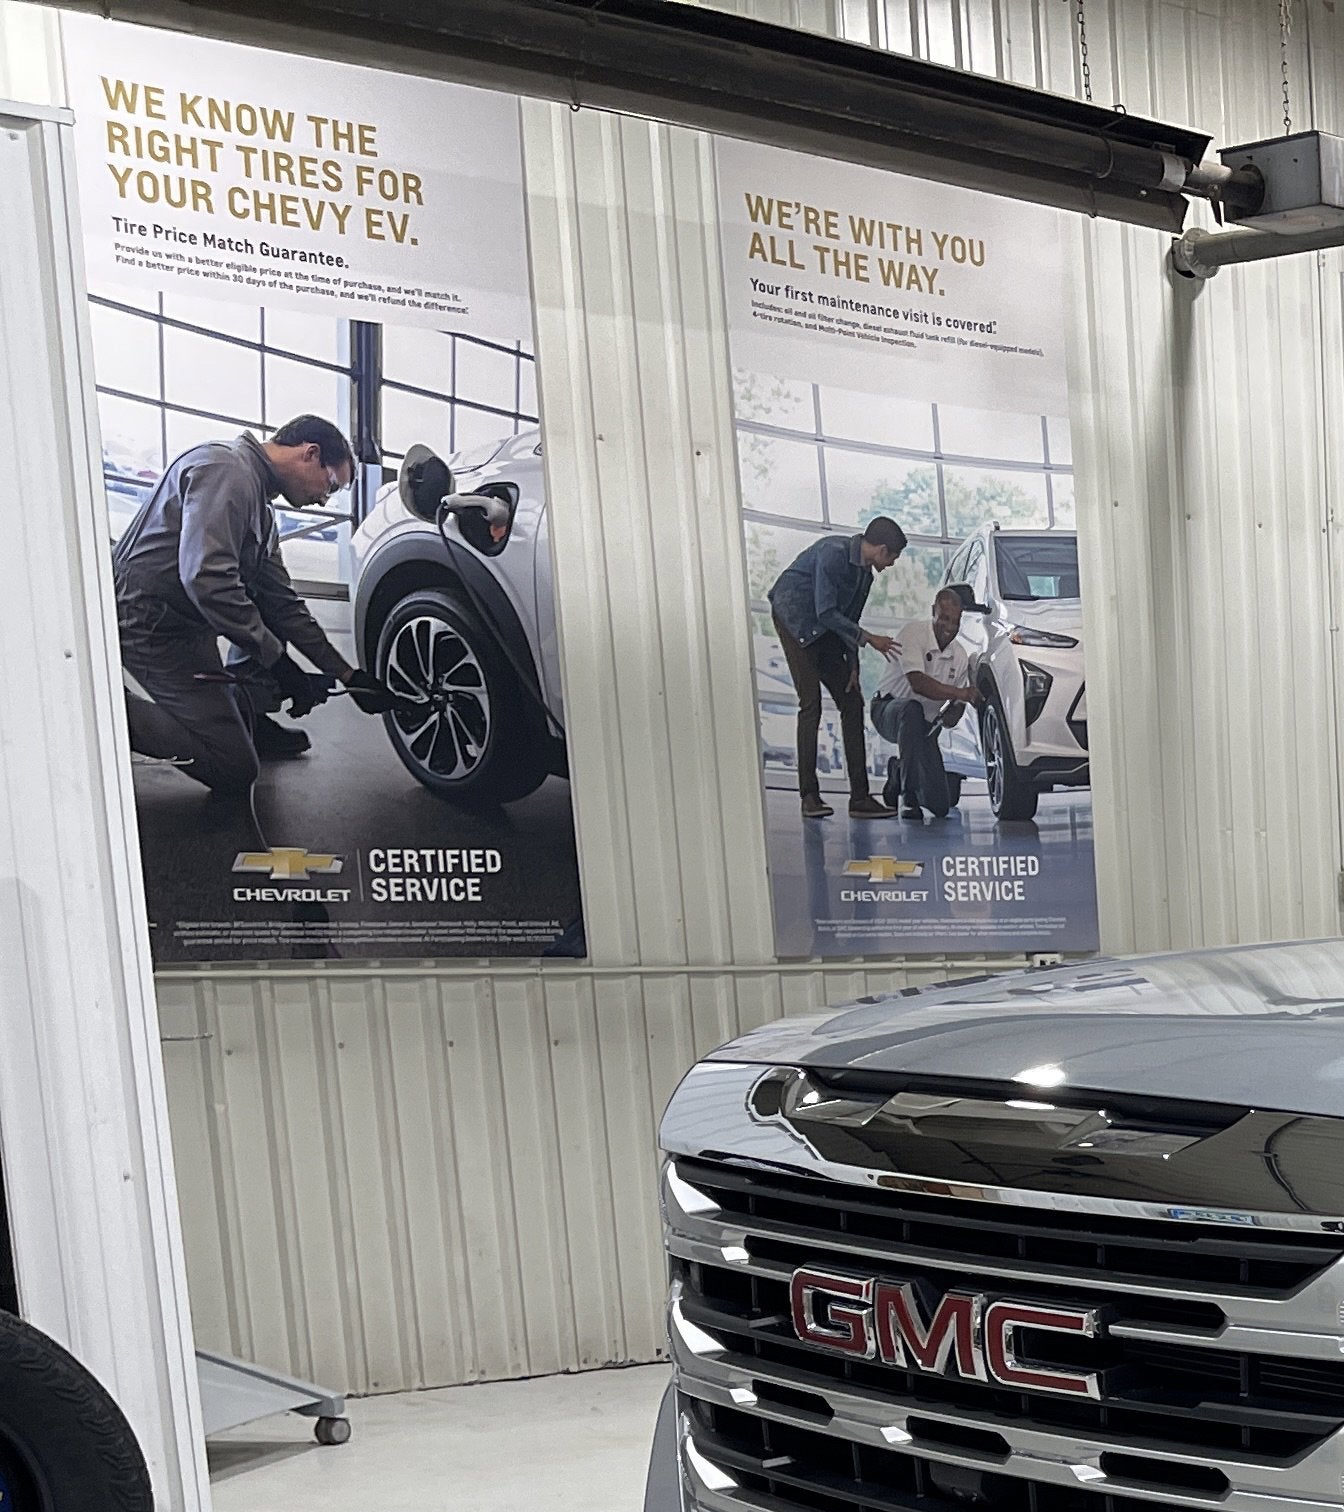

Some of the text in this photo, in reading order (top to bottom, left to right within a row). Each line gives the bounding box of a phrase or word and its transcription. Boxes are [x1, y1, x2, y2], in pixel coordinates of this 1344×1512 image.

[101, 75, 378, 157] WE KNOW THE
[107, 121, 424, 206] RIGHT TIRES FOR
[107, 163, 420, 246] YOUR CHEVY EV.
[745, 193, 985, 267] WE'RE WITH YOU
[112, 216, 349, 270] Tire Price Match Guarantee.
[749, 232, 945, 296] ALL THE WAY.
[114, 243, 149, 256] Provide
[165, 252, 185, 262] with
[195, 255, 223, 268] better
[226, 262, 257, 274] eligible
[260, 267, 281, 278] price
[295, 272, 309, 281] the
[311, 274, 330, 284] time
[332, 277, 341, 285] of
[387, 286, 401, 294] and
[425, 291, 450, 301] match
[116, 255, 135, 266] Find
[146, 260, 174, 272] better
[177, 266, 200, 277] price
[202, 270, 230, 281] within
[232, 274, 243, 283] 30
[246, 277, 266, 288] days
[268, 280, 277, 288] of
[279, 282, 293, 291] the
[340, 290, 354, 299] and
[378, 295, 406, 306] refund
[408, 299, 422, 308] the
[751, 277, 781, 296] Your
[785, 285, 814, 304] first
[818, 294, 899, 320] maintenance
[902, 308, 929, 325] visit
[932, 311, 942, 326] is
[368, 848, 502, 874] CERTIFIED
[942, 855, 1040, 877] CERTIFIED
[232, 877, 483, 902] CHEVROLET SERVICE
[840, 881, 1026, 902] CHEVROLET SERVICE
[790, 1266, 1101, 1401] GMC
